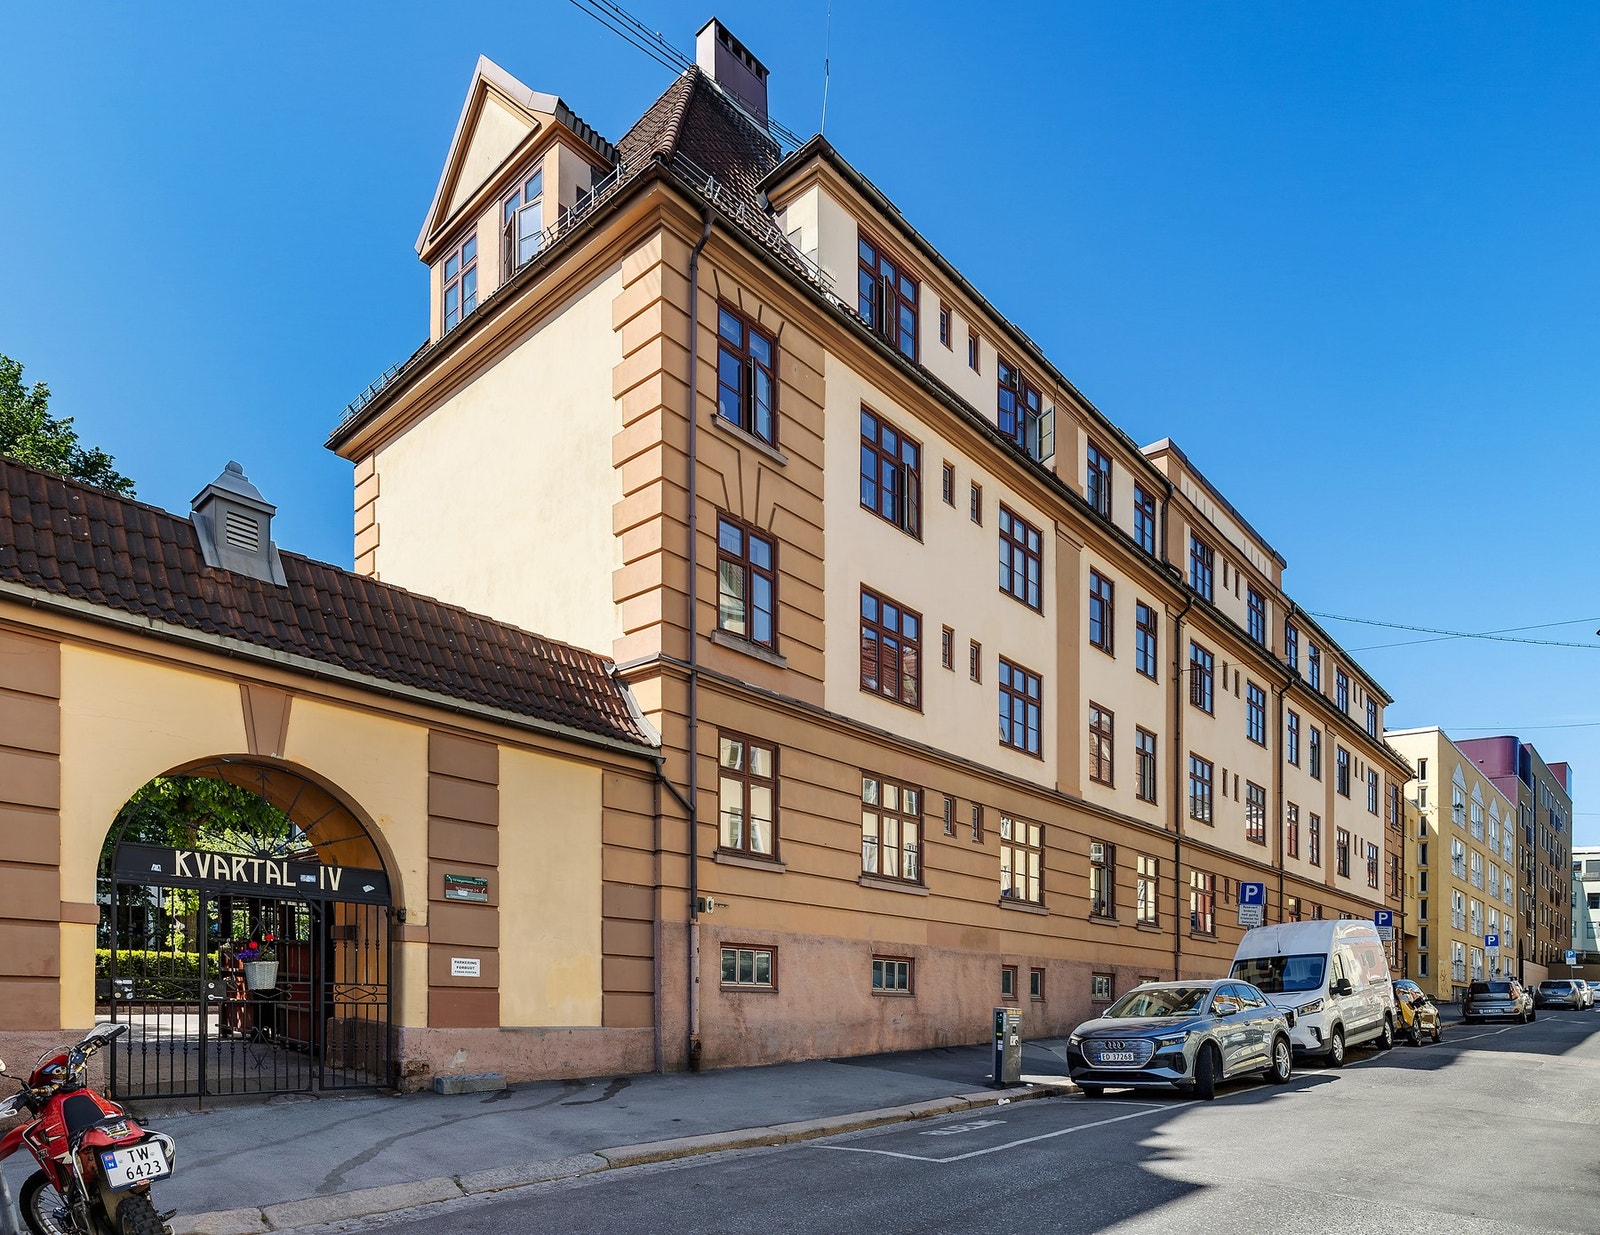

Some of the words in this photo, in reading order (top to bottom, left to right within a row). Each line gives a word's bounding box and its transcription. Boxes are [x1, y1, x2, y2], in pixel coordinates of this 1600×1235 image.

[174, 850, 297, 887] KVARTAL
[319, 866, 343, 891] IV
[1245, 885, 1259, 902] P
[1378, 912, 1389, 925] P
[1488, 936, 1496, 946] P
[1112, 1053, 1133, 1061] 37268
[127, 1147, 149, 1163] TW
[126, 1160, 162, 1180] 6423
